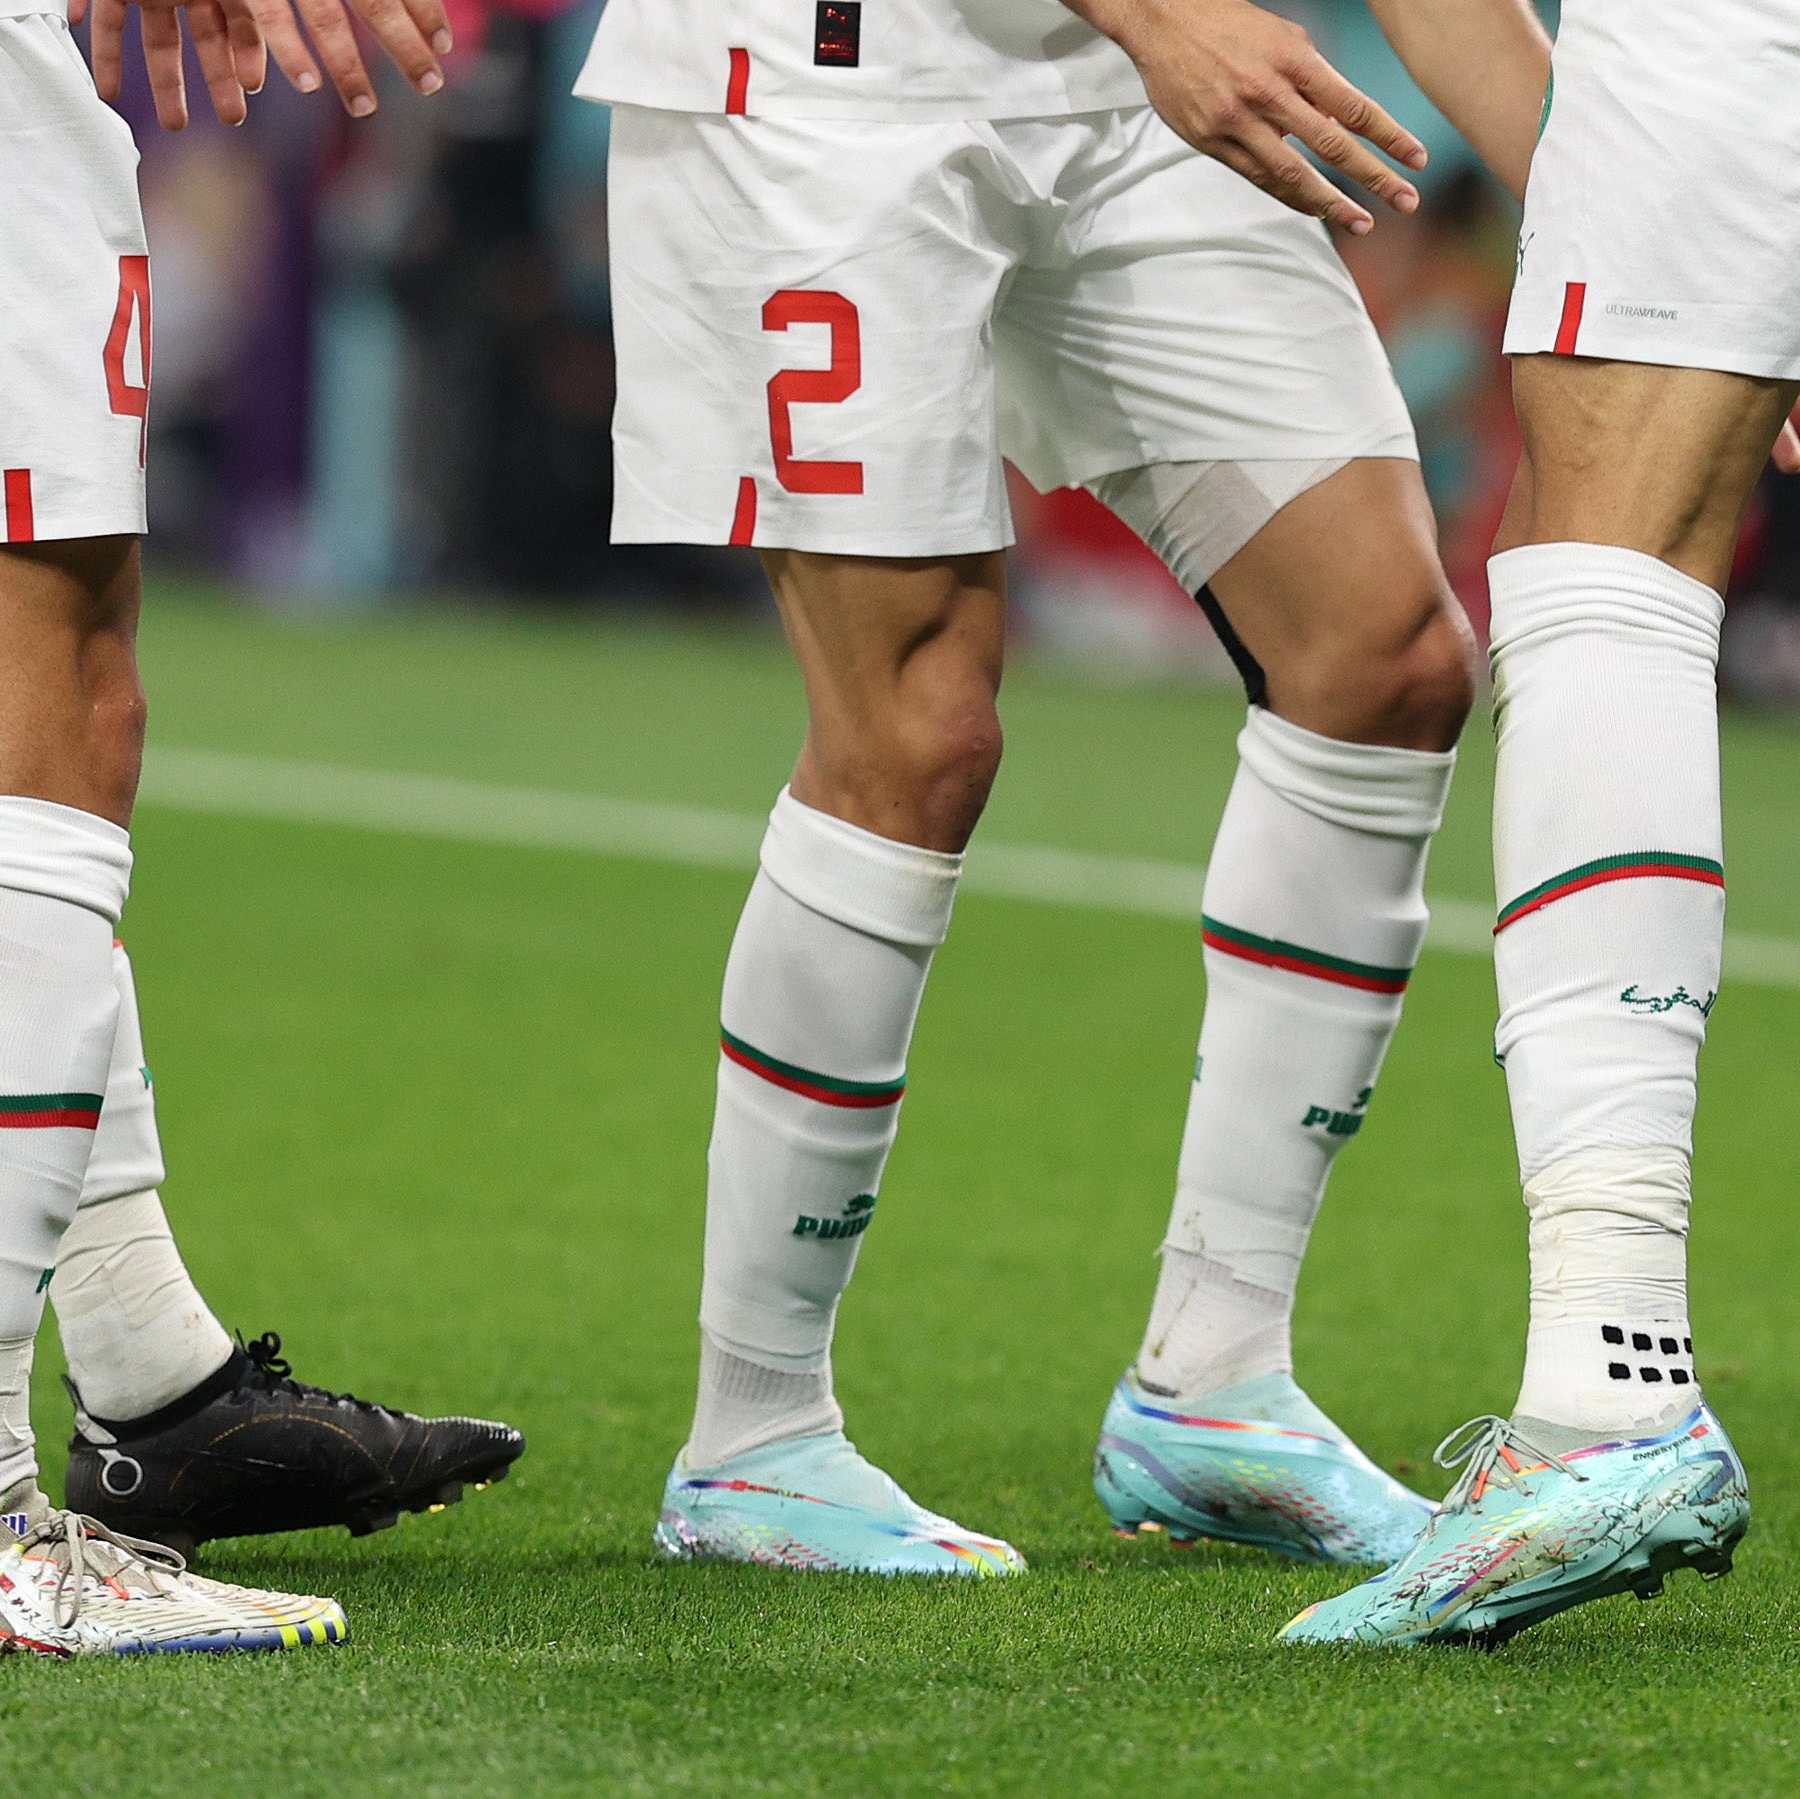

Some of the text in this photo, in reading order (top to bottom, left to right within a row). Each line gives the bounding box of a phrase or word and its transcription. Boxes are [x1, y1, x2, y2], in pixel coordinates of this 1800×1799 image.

[102, 255, 152, 468] 4
[761, 289, 863, 494] 2
[1605, 303, 1679, 320] ULTRAWEAVE
